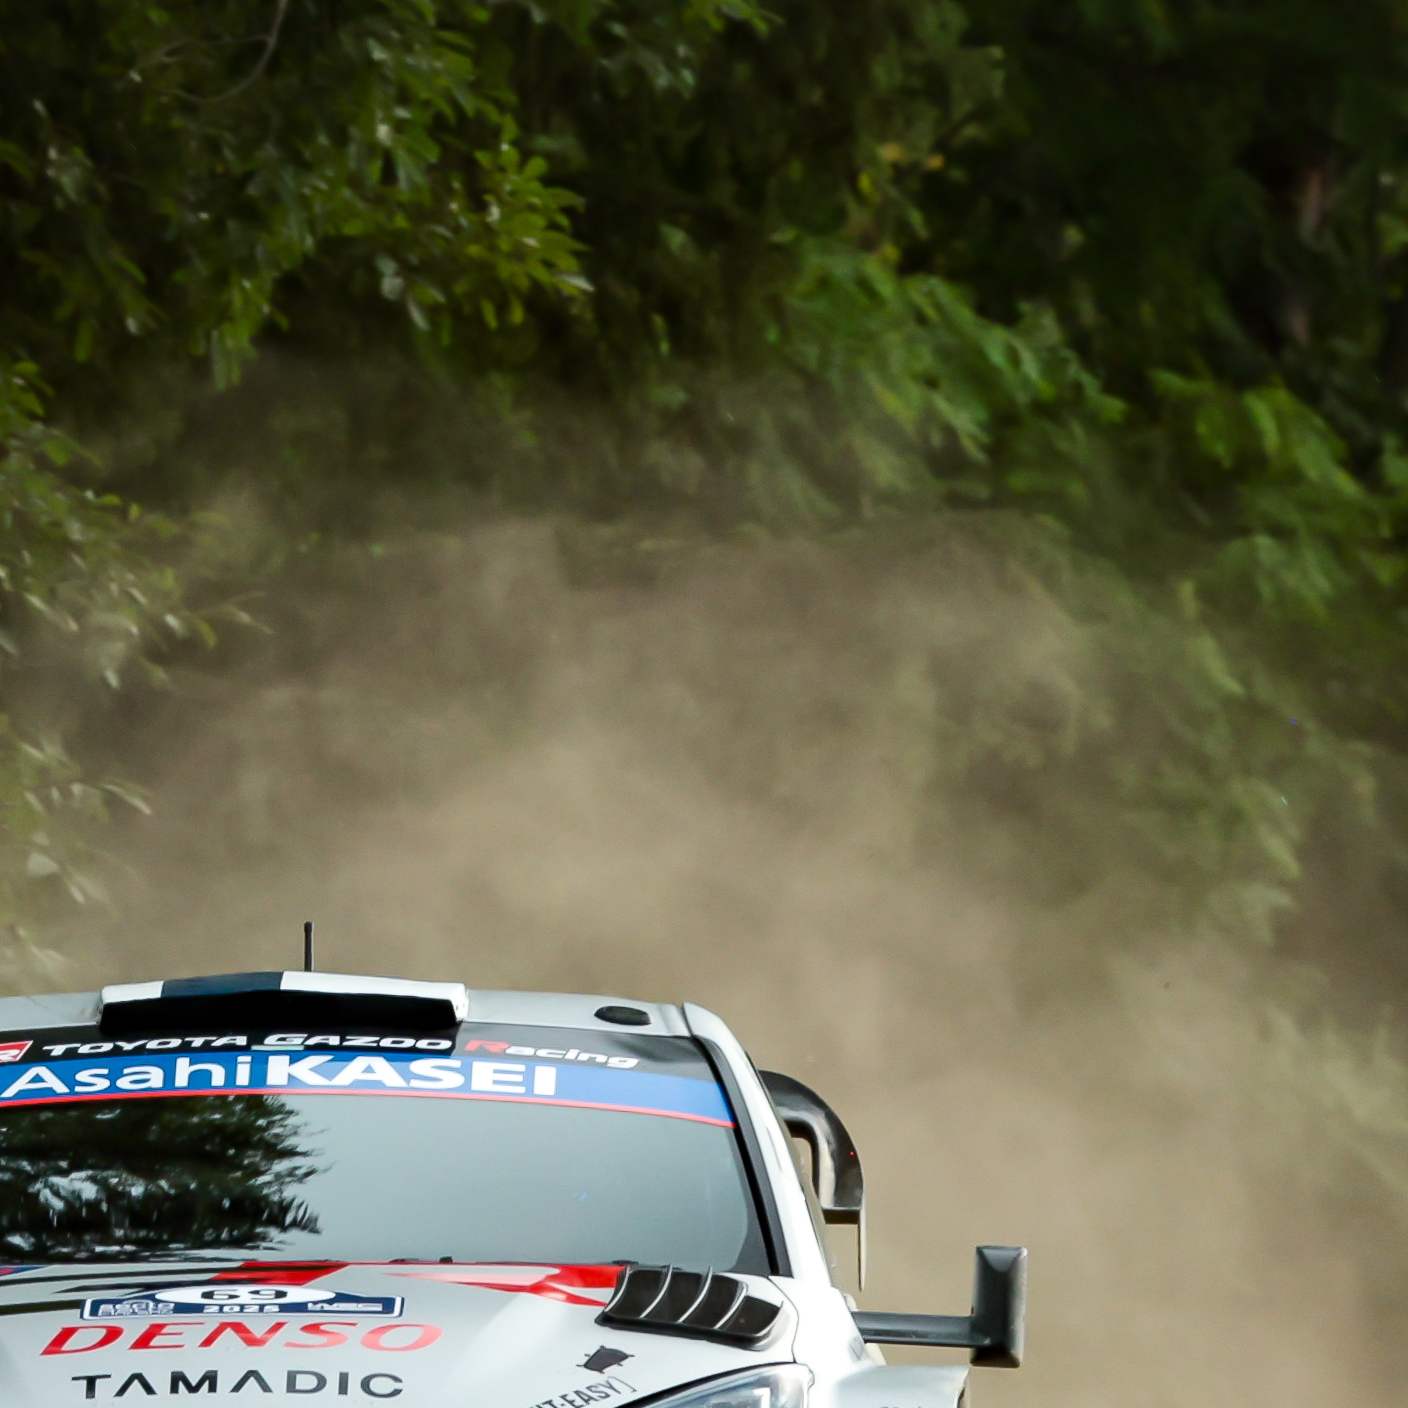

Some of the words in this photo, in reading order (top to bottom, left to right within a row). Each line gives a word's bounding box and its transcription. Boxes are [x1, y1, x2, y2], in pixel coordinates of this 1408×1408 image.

[43, 1035, 247, 1057] TOYOTA
[263, 1033, 453, 1050] GAZOO
[464, 1040, 640, 1069] Racing
[201, 1288, 288, 1300] 69
[39, 1321, 443, 1356] DENSO
[71, 1369, 403, 1399] TAMADIC
